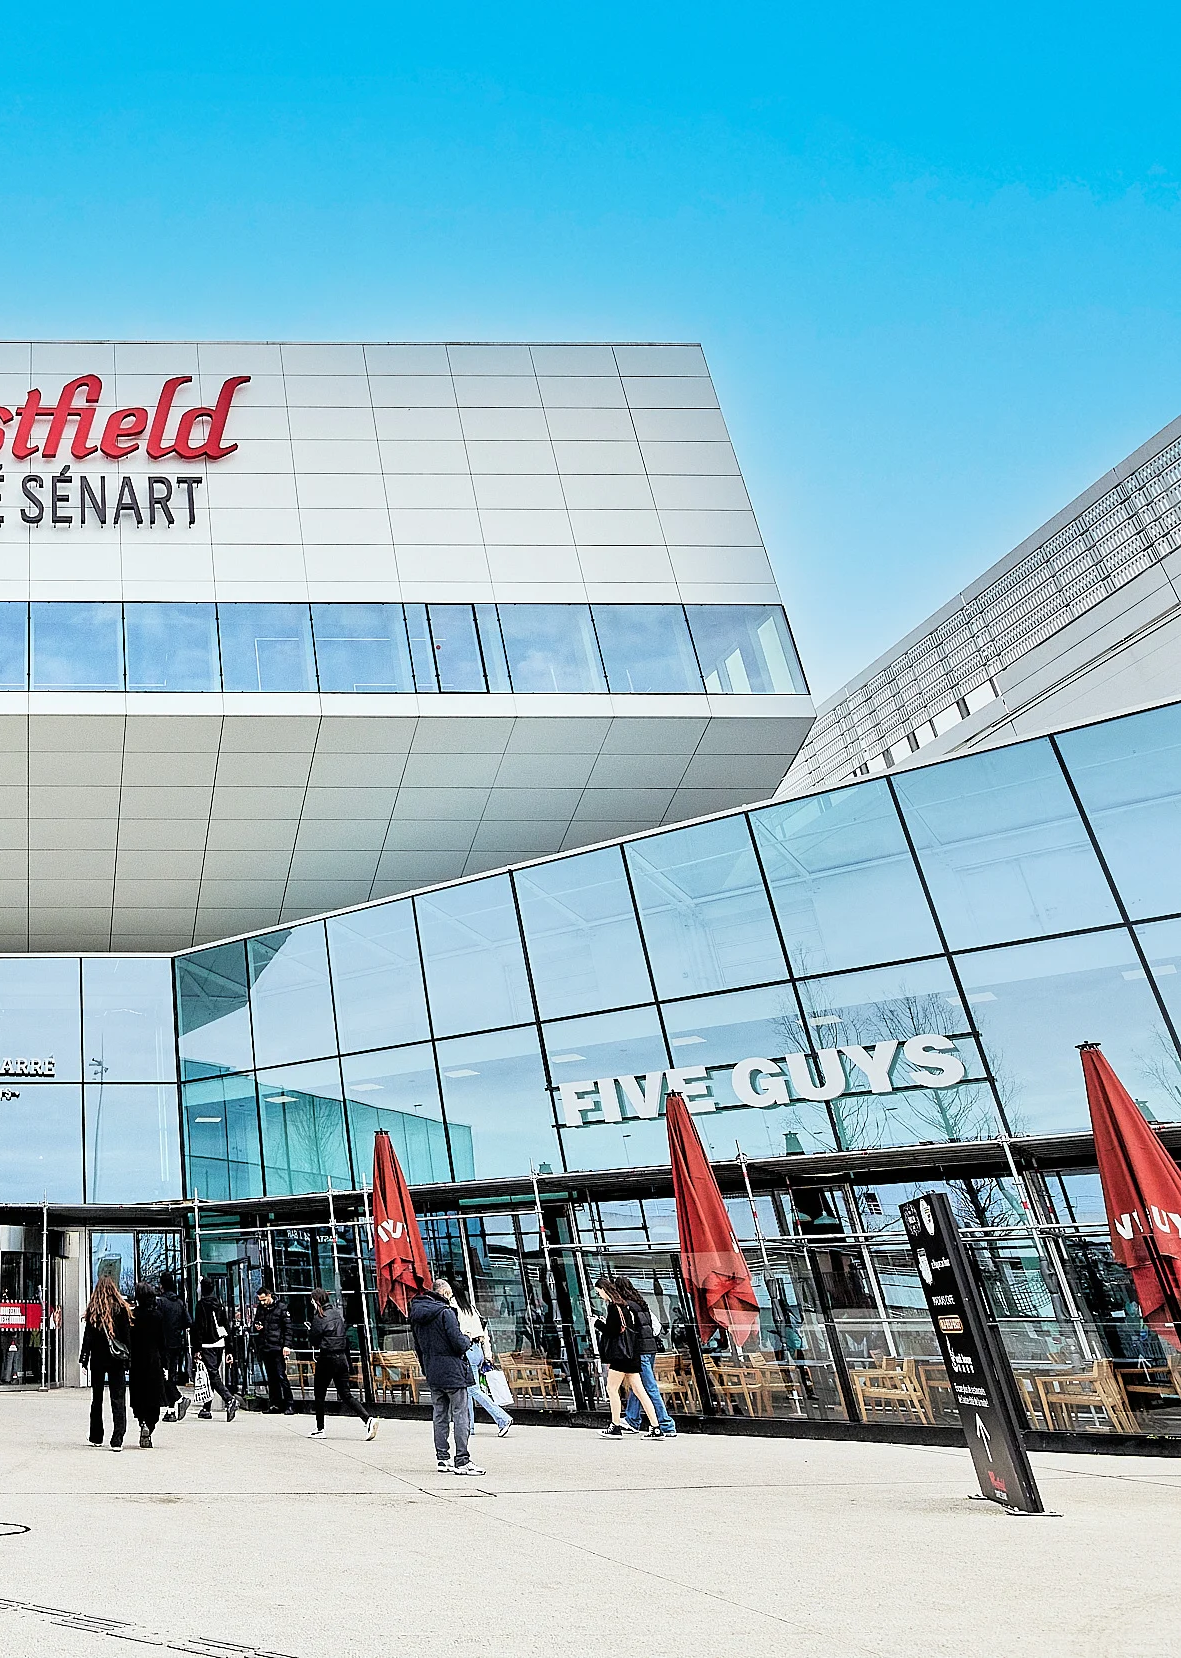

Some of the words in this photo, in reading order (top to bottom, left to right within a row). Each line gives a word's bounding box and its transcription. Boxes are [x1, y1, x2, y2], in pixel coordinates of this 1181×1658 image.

[19, 464, 203, 526] SÉNART
[558, 1065, 716, 1126] FIVE
[731, 1034, 967, 1109] GUYS
